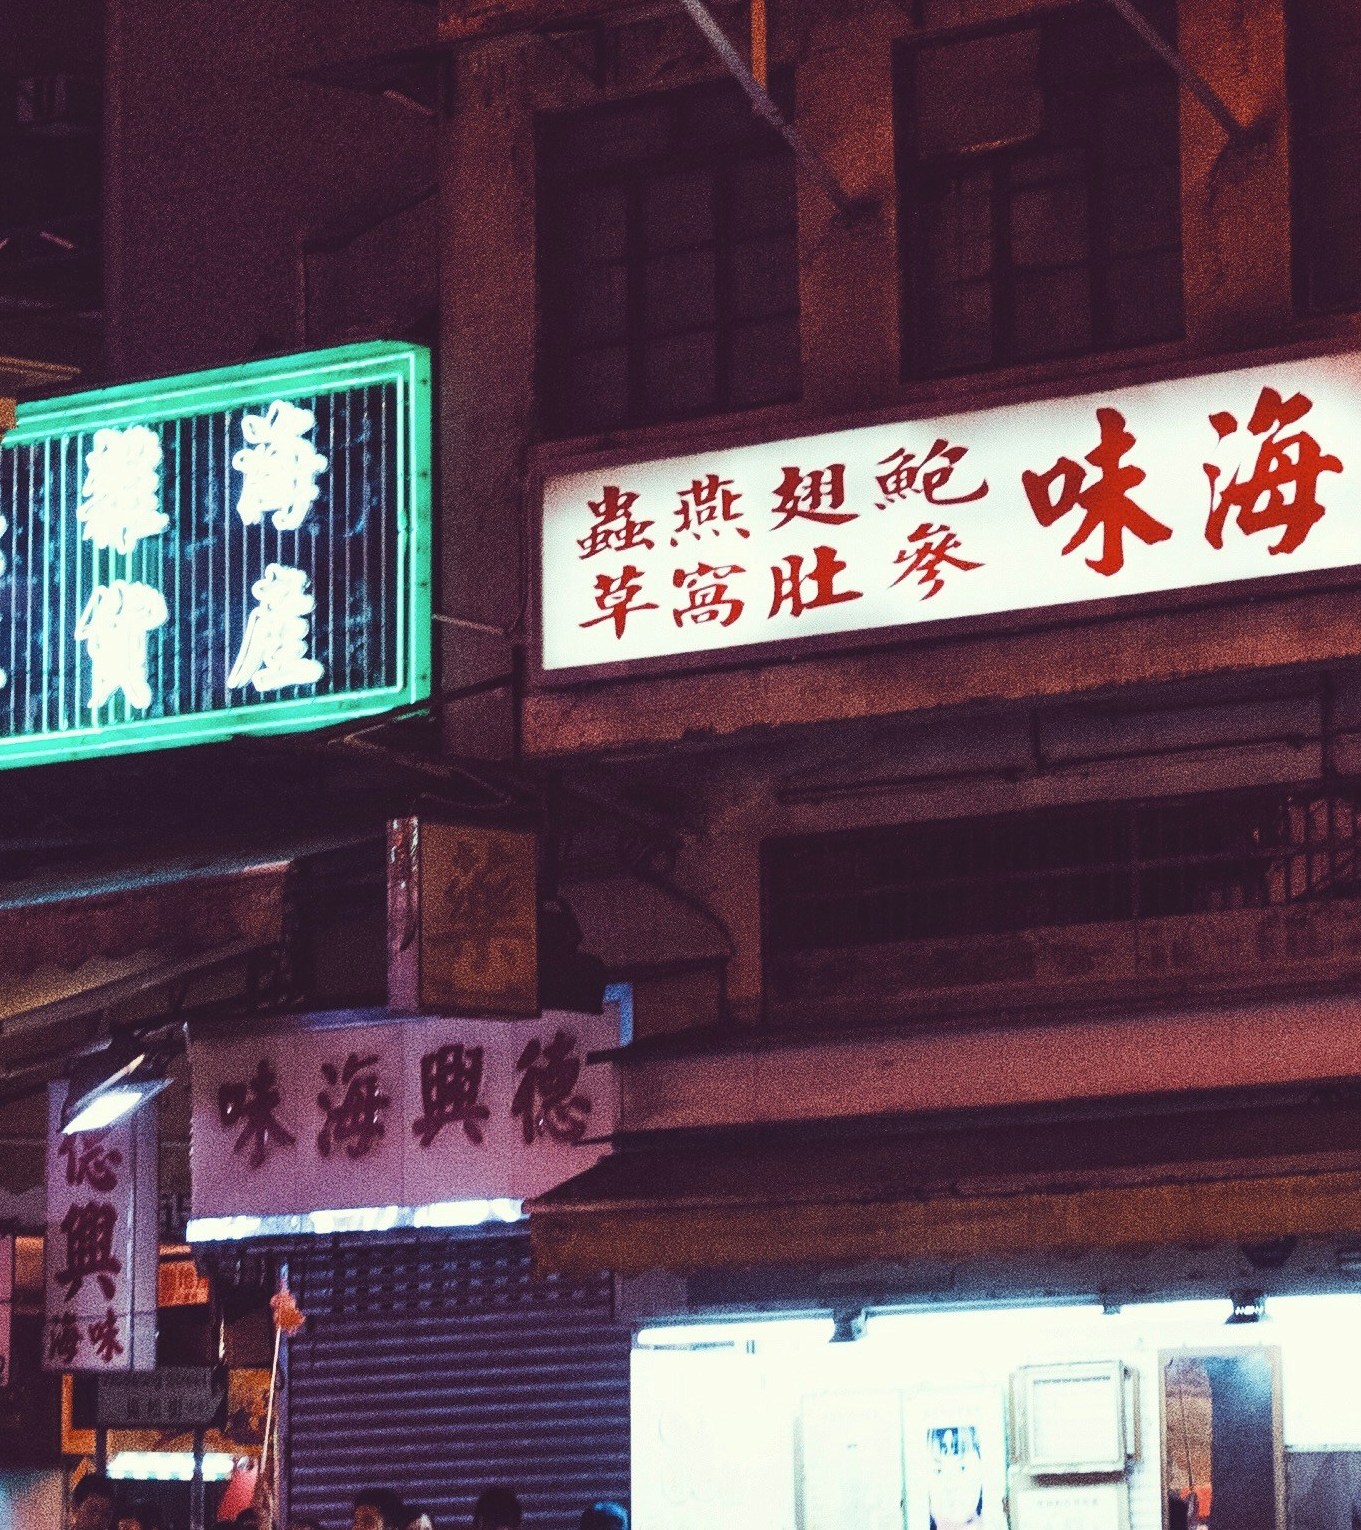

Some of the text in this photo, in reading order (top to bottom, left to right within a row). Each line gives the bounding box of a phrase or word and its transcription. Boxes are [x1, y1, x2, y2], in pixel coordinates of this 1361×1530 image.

[576, 483, 658, 640] 蟲草
[669, 471, 751, 631] 燕窩
[764, 460, 865, 621] 翅肚
[218, 1030, 593, 1171] 德興海味
